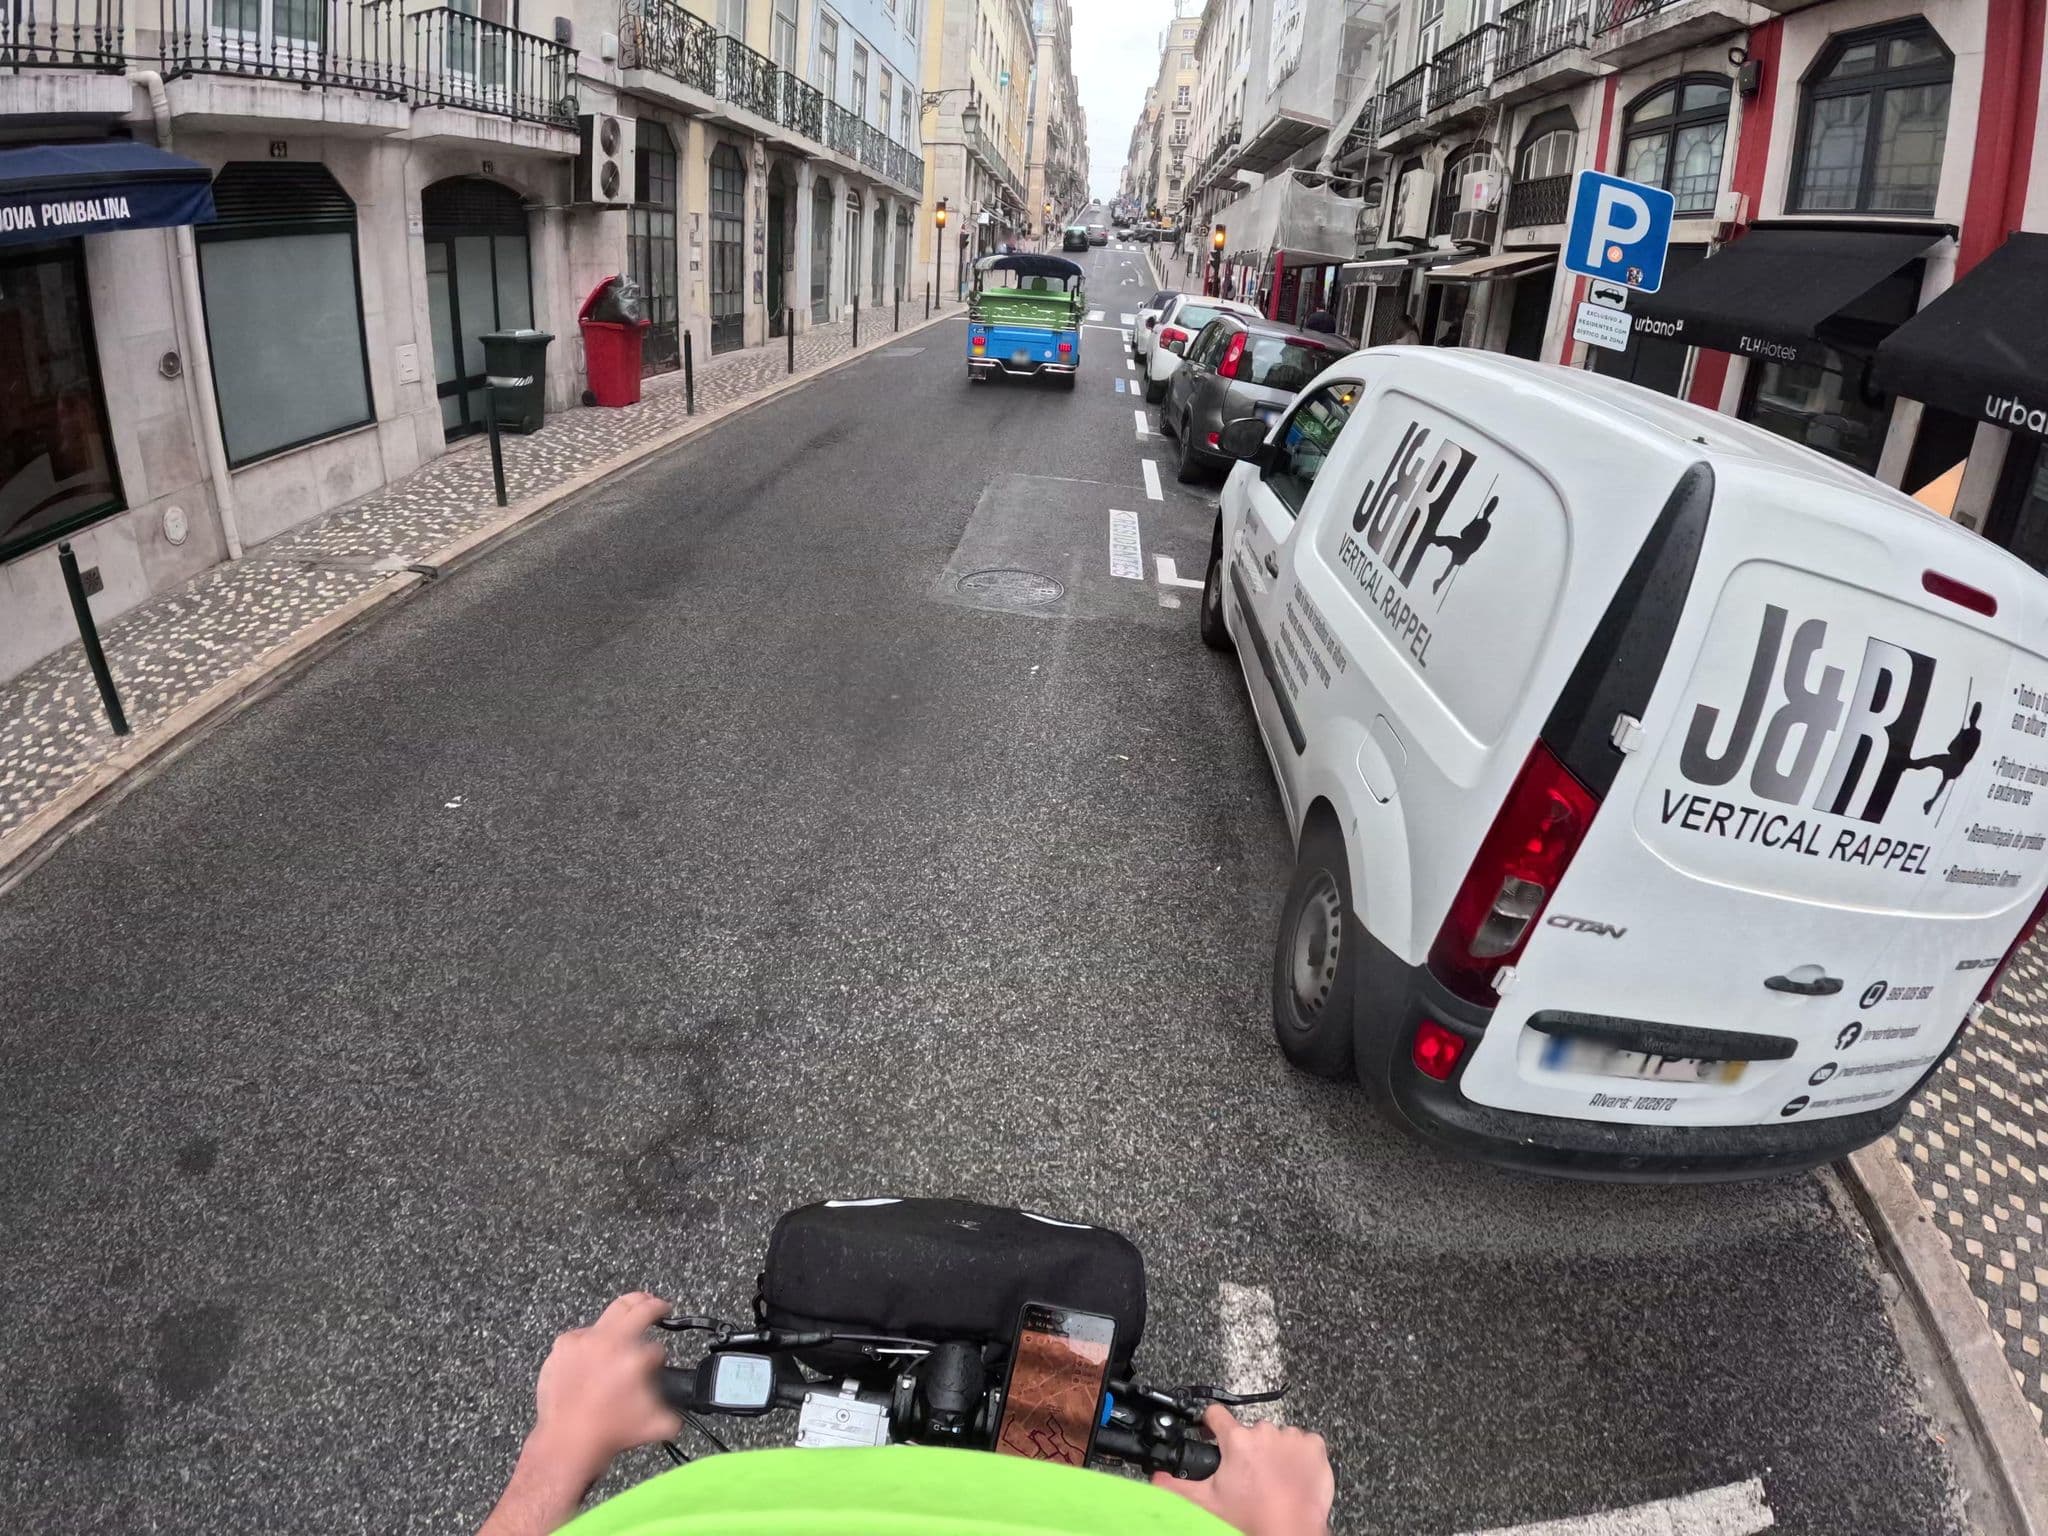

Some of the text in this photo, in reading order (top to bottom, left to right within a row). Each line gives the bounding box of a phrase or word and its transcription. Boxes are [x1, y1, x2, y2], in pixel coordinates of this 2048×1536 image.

[0, 197, 131, 232] OVA POMBALINA
[1586, 184, 1651, 268] P
[1635, 316, 1675, 337] urbano
[1985, 394, 2048, 435] urba
[1352, 420, 1478, 590] J&R
[1338, 532, 1433, 669] VERTICAL RAPPEL
[1680, 603, 1937, 824] J&R
[1660, 788, 1930, 875] VERTICAL RAPPEL
[1547, 915, 1628, 939] CITAN
